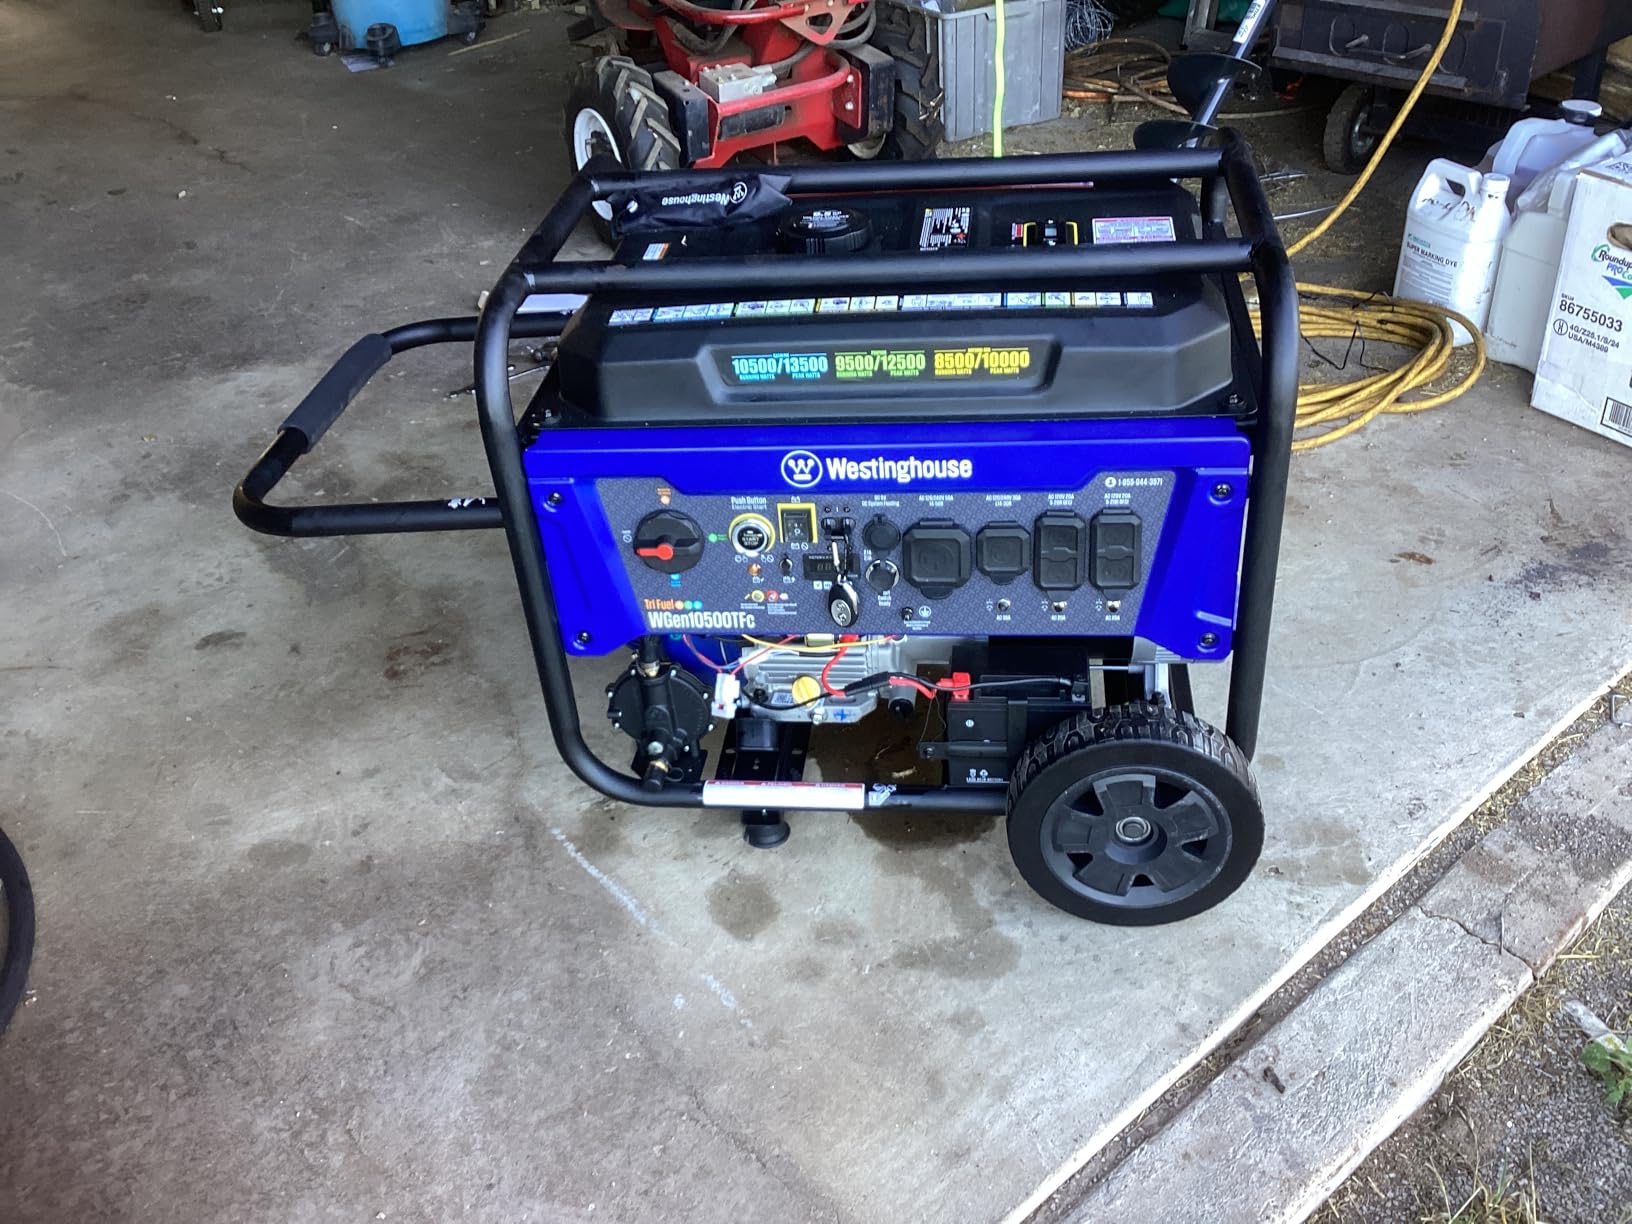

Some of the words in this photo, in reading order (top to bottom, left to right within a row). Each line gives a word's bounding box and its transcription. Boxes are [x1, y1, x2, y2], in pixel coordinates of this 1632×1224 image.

[661, 192, 730, 206] Westinghouse
[1420, 248, 1444, 264] MARKING
[1445, 258, 1458, 268] DYE
[1598, 249, 1632, 271] Roundup
[1559, 299, 1623, 332] 86755033
[731, 356, 828, 375] 10500/13500
[834, 353, 926, 372] 9500/12500
[934, 351, 1030, 369] 8500/10000
[825, 456, 973, 484] Westinghouse
[746, 495, 767, 505] Button
[643, 599, 656, 610] Tri
[656, 599, 675, 610] Fuel
[648, 611, 756, 629] WGen10500TFc
